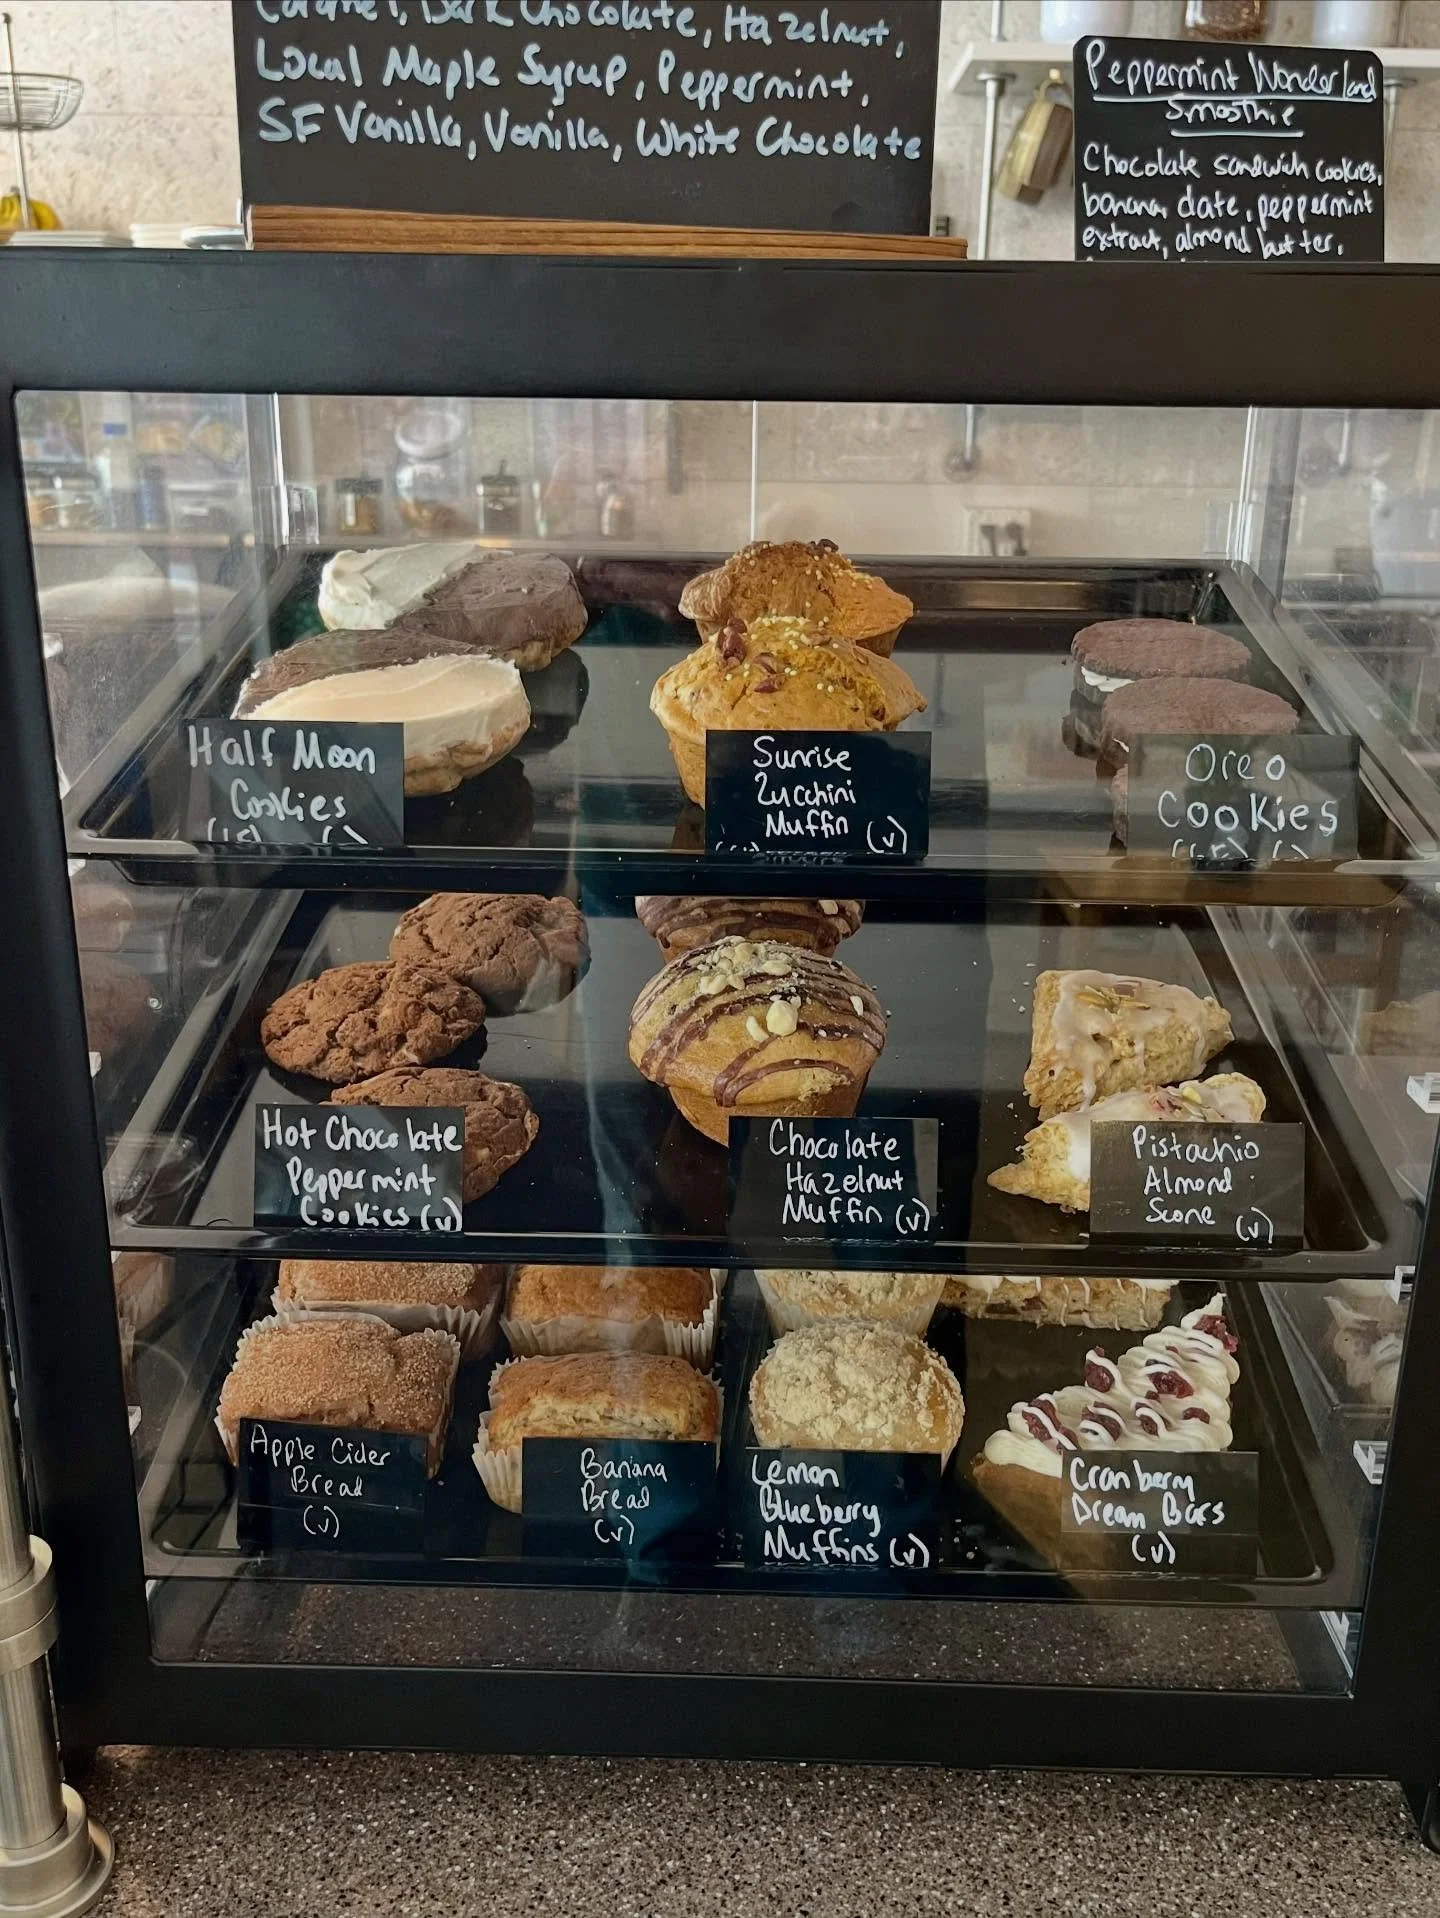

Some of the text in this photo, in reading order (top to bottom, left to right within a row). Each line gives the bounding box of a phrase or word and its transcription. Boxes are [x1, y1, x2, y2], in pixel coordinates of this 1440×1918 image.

[520, 0, 711, 48] Chocolate,
[724, 4, 905, 58] Hazelnut,
[256, 38, 363, 87] Local
[382, 45, 500, 100] Maple
[517, 43, 645, 106] Syrup,
[1085, 39, 1240, 96] Peppermint
[258, 97, 921, 162] SF Vanilla, Vanilla, White Chocolate
[1083, 143, 1200, 178] Chocolate
[1177, 184, 1253, 223] date,
[1257, 189, 1374, 232] peppermint
[1082, 222, 1169, 260] extract,
[1175, 222, 1252, 254] almond
[188, 725, 376, 775] Half Moon
[752, 735, 853, 771] Sunrise
[1185, 743, 1287, 782] Oreo
[230, 778, 347, 822] Cookies
[754, 771, 857, 807] Zucchini
[765, 809, 849, 839] Muffin
[1158, 789, 1338, 837] Cookies
[262, 1108, 463, 1153] Hot Chocolate
[769, 1118, 901, 1161] Chocolate
[1132, 1124, 1260, 1164] Pistachio
[286, 1155, 437, 1204] Peppermint
[786, 1161, 904, 1196] Hazelnut
[1143, 1165, 1233, 1196] Almond
[300, 1195, 411, 1227] Cookies
[782, 1193, 883, 1225] Muffin
[1145, 1197, 1216, 1225] Scone
[250, 1423, 391, 1467] Apple Cider
[290, 1465, 363, 1497] Bread
[580, 1447, 668, 1483] Banana
[751, 1454, 840, 1488] Lemon
[1069, 1457, 1196, 1502] Cranberry
[581, 1478, 650, 1512] Bread
[759, 1484, 882, 1538] Blueberry
[1071, 1491, 1226, 1529] Dream Bars
[763, 1524, 880, 1565] Muffins
